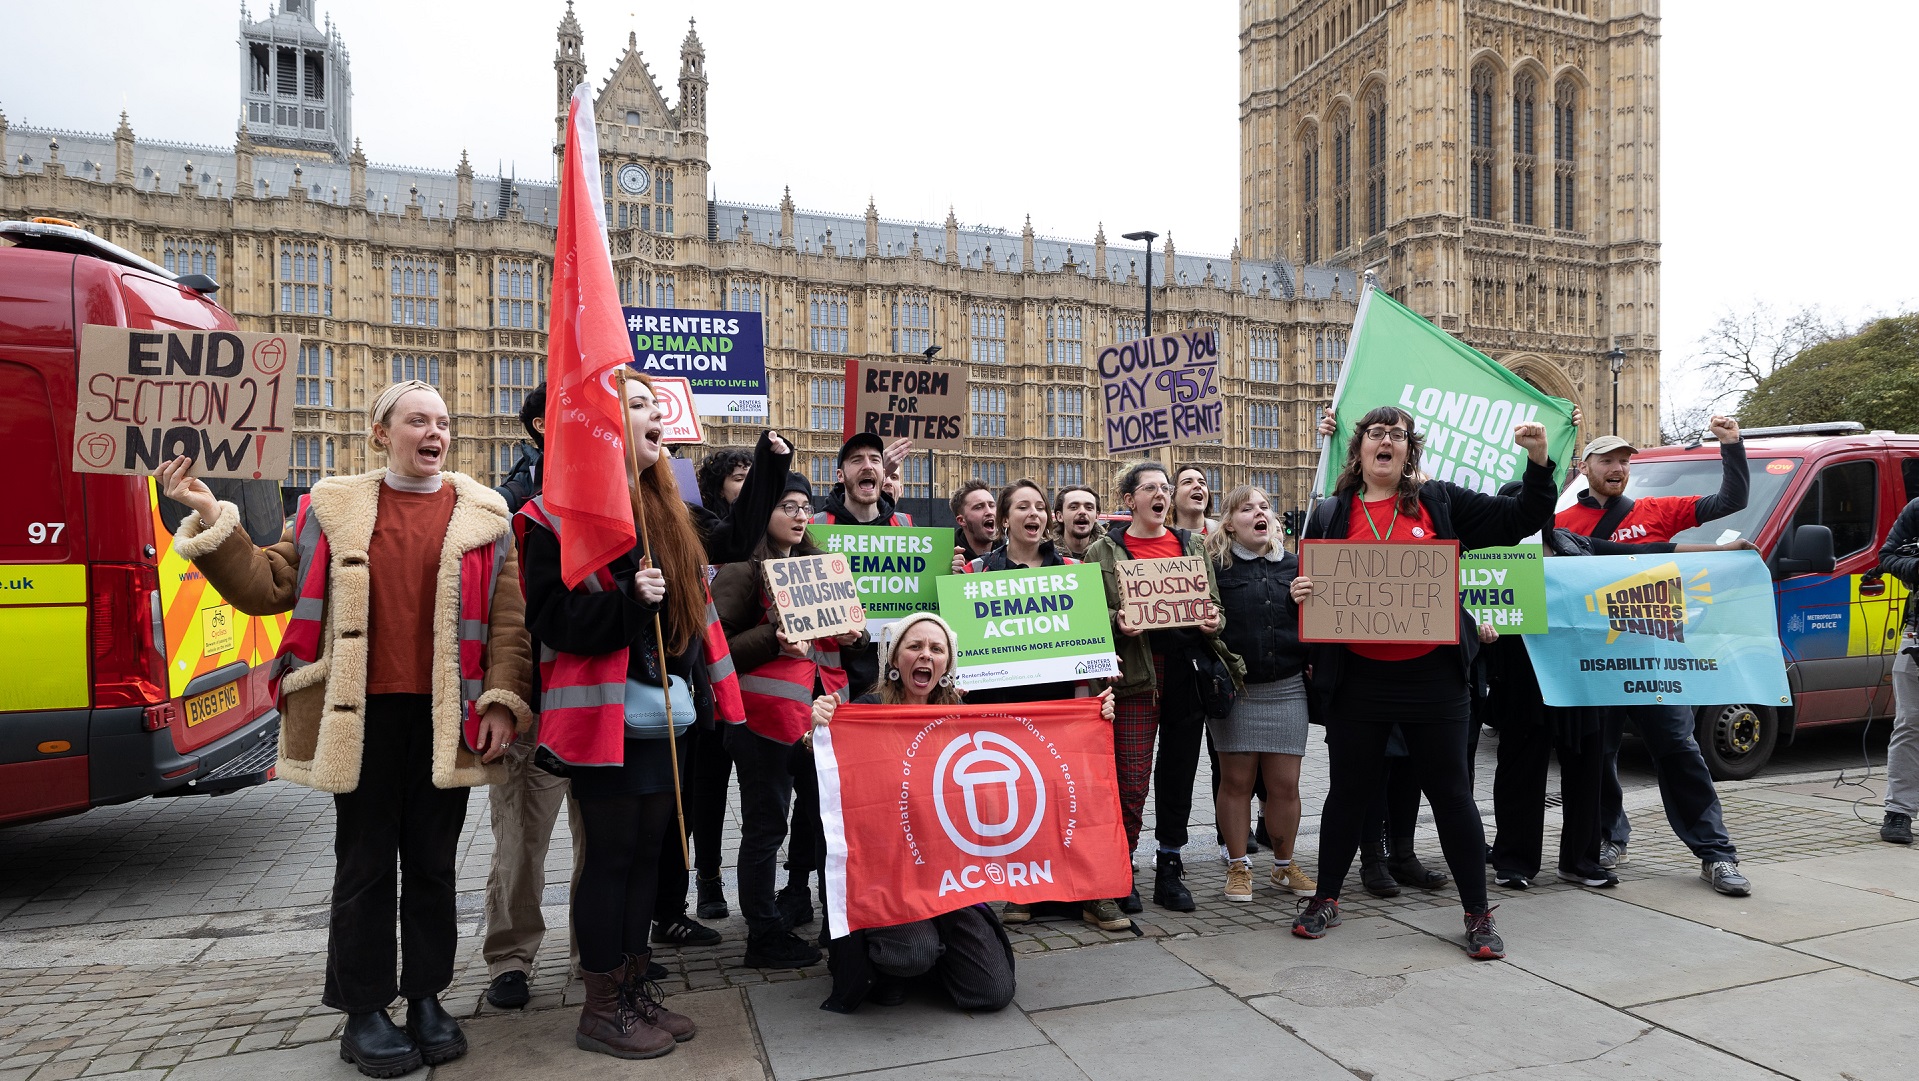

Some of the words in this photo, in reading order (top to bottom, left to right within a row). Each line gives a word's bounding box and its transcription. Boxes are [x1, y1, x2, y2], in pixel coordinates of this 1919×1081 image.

[628, 315, 740, 335] #RENTERS
[129, 332, 245, 378] END
[637, 334, 733, 353] DEMAND
[1098, 336, 1180, 379] COULD
[1182, 332, 1217, 362] YOU
[643, 353, 727, 372] ACTION
[691, 379, 713, 387] SAFE
[715, 379, 726, 387] TO
[728, 380, 746, 388] LIVE
[748, 380, 759, 388] IN
[865, 368, 949, 396] REFORM
[1104, 372, 1153, 414] PAY
[1155, 367, 1217, 403] 95%
[86, 373, 229, 425] SECTION
[231, 373, 285, 433] 21
[888, 394, 918, 413] FOR
[864, 411, 961, 440] RENTERS
[1106, 409, 1169, 448] MORE
[1171, 400, 1223, 439] RENT?
[1398, 384, 1539, 456] LONDON
[124, 426, 267, 480] NOW!
[1402, 408, 1518, 481] ENTERS
[28, 522, 66, 544] 97
[827, 534, 933, 554] #RENTERS
[848, 555, 926, 573] EMAND
[1121, 563, 1145, 577] WE
[1153, 559, 1203, 574] WANT
[1311, 548, 1448, 578] LANDLORD
[1468, 552, 1502, 560] RENTING
[0, 576, 34, 590] .uk
[178, 571, 206, 582] www.
[772, 558, 828, 587] SAFE
[788, 580, 856, 608] HOUSING
[963, 573, 1079, 600] #RENTERS
[1126, 574, 1208, 598] HOUSING
[1311, 581, 1443, 608] REGISTER
[1606, 576, 1682, 605] LONDON
[869, 603, 914, 611] RENTING
[974, 594, 1074, 619] DEMAND
[1129, 598, 1214, 626] JUSTICE
[1606, 604, 1683, 620] RENTERS
[1807, 613, 1842, 621] METROPOLITAN
[784, 613, 815, 634] FOR
[817, 605, 848, 628] ALL!
[983, 613, 1070, 639] ACTION
[1351, 611, 1412, 635] NOW
[1608, 619, 1685, 644] UNION
[1811, 621, 1837, 629] POLICE
[965, 648, 990, 657] MAKE
[991, 644, 1028, 655] RENTING
[1029, 641, 1053, 651] MORE
[1055, 636, 1106, 648] AFFORDABLE
[1580, 657, 1661, 672] DISABILITY
[1663, 657, 1718, 671] JUSTICE
[1623, 679, 1682, 693] CAUCUS
[190, 694, 218, 722] BX69
[1047, 742, 1061, 759] for
[902, 760, 912, 776] of
[1060, 763, 1077, 813] Reform
[899, 781, 925, 865] Association
[1063, 818, 1077, 848] Now
